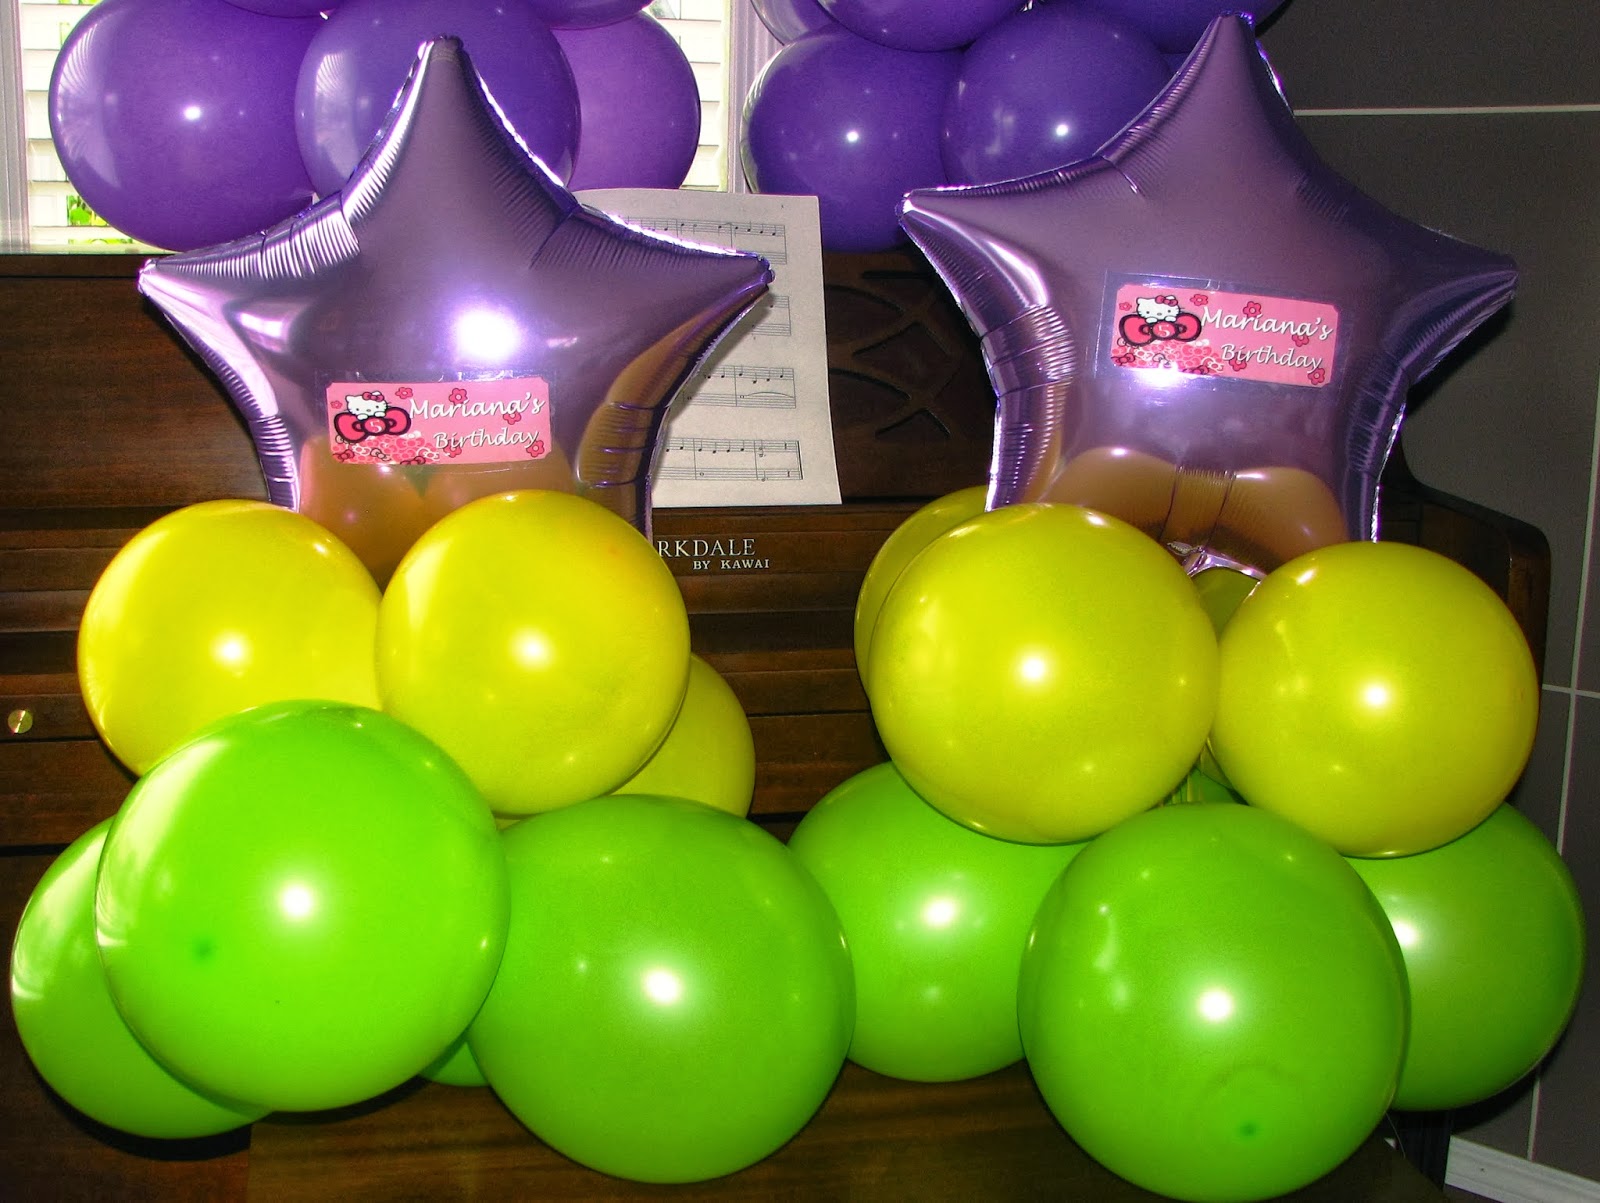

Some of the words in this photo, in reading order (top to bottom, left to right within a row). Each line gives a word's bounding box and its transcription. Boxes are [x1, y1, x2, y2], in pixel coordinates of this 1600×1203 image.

[1158, 323, 1171, 338] 5
[1201, 306, 1333, 341] Mariana's
[1221, 343, 1322, 372] Birthday
[409, 392, 545, 420] Mariana's
[370, 419, 383, 434] 5
[433, 427, 539, 449] Birthday
[657, 538, 756, 557] RKDALE
[693, 560, 711, 570] BY
[720, 559, 770, 569] KAWAI
